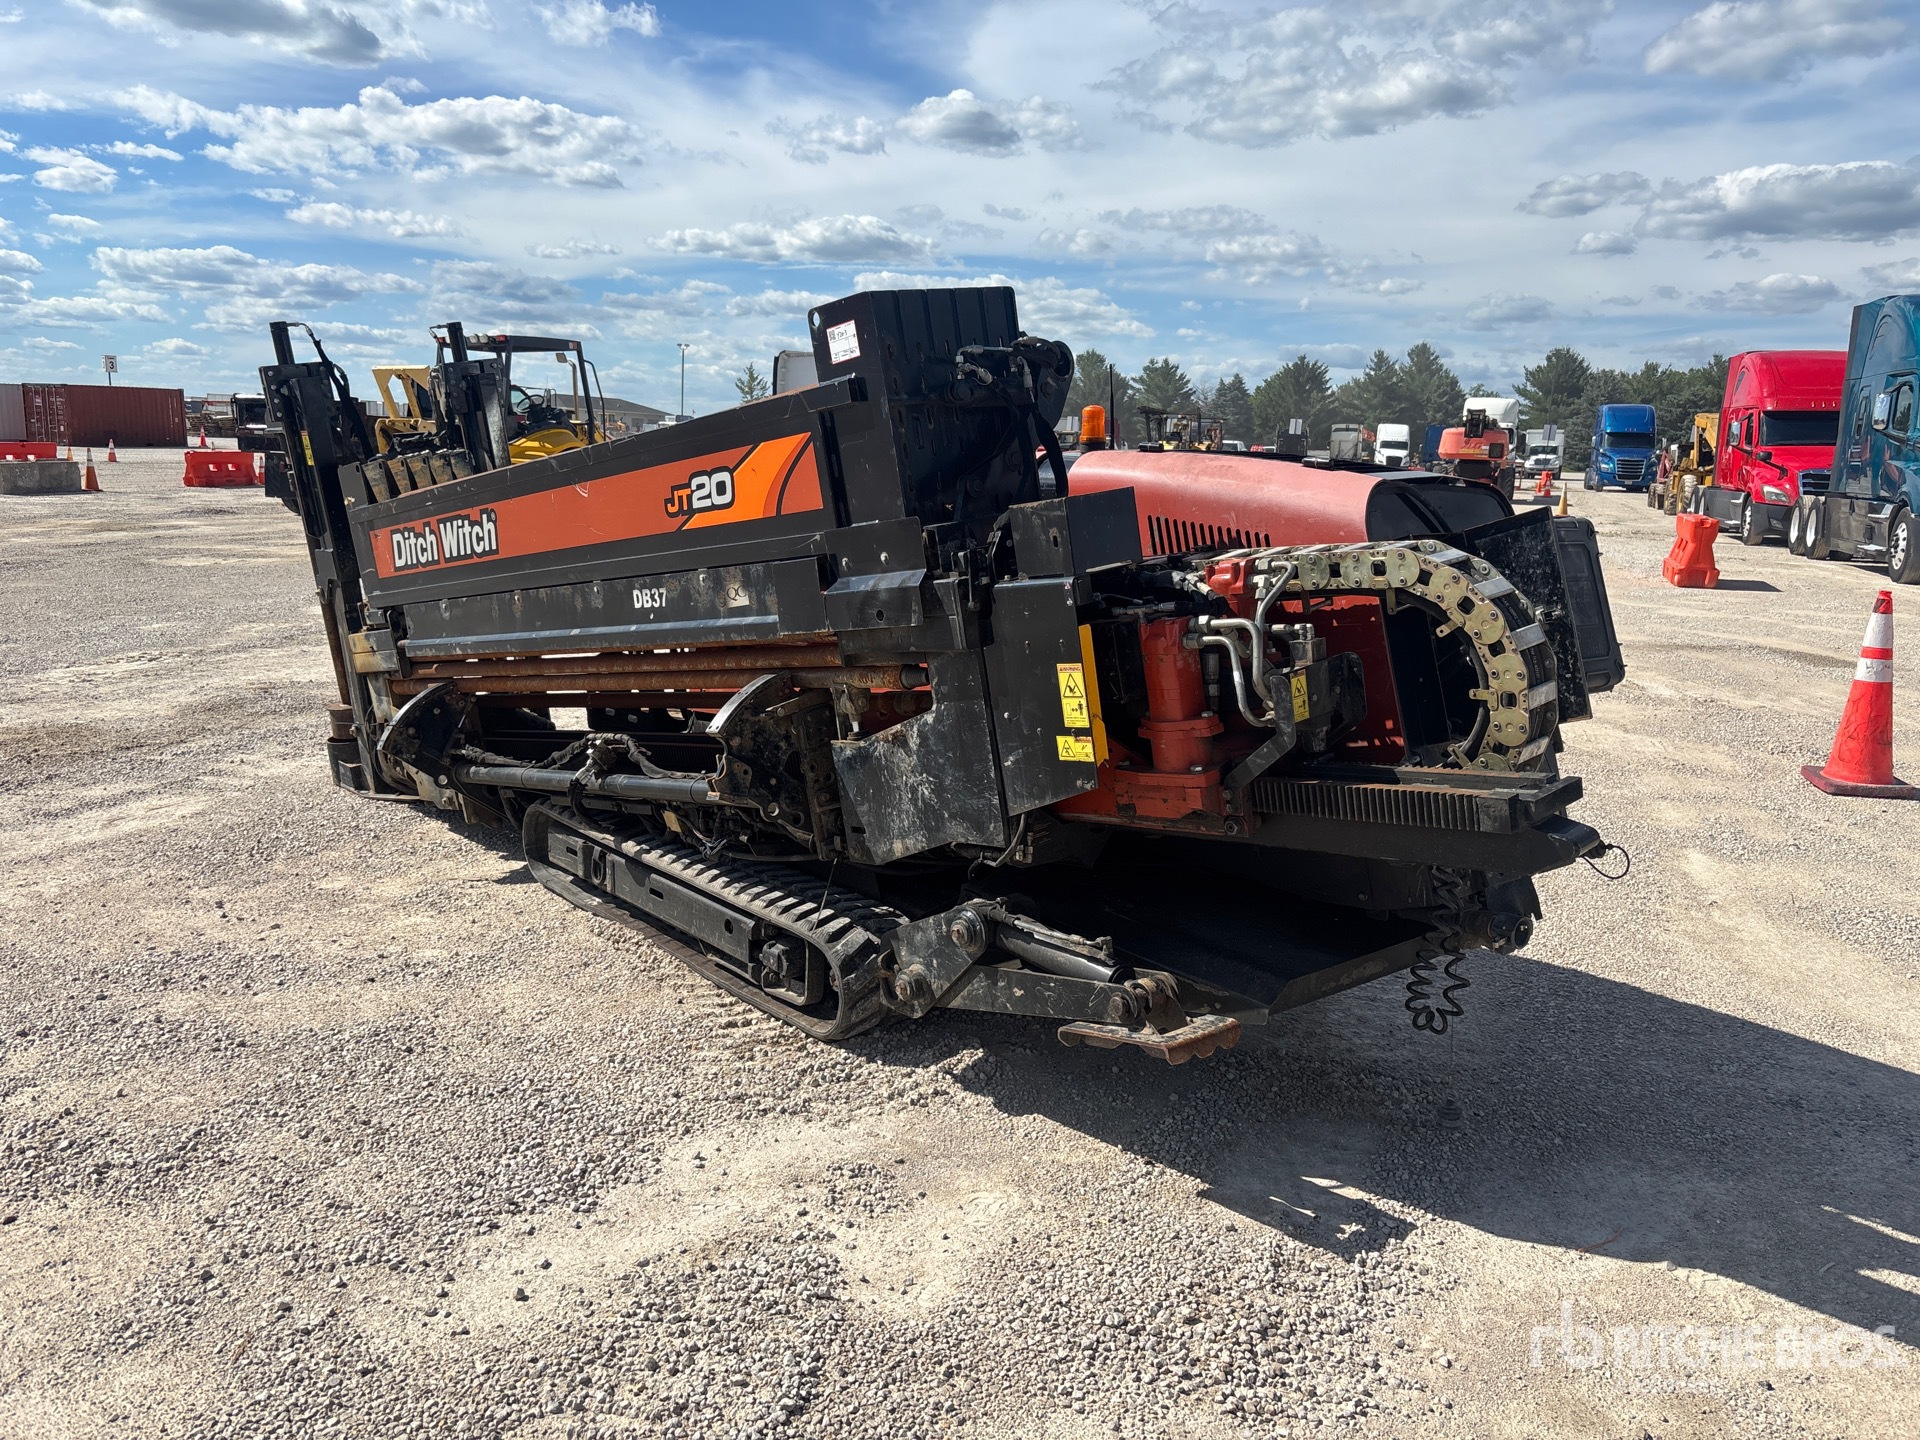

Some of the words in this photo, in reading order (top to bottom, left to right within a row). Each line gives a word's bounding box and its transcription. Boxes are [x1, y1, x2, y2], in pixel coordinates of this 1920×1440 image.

[109, 361, 115, 370] 3
[667, 472, 732, 513] JT20
[392, 526, 439, 568] Ditch
[439, 514, 497, 559] Witch
[632, 588, 667, 609] DB37
